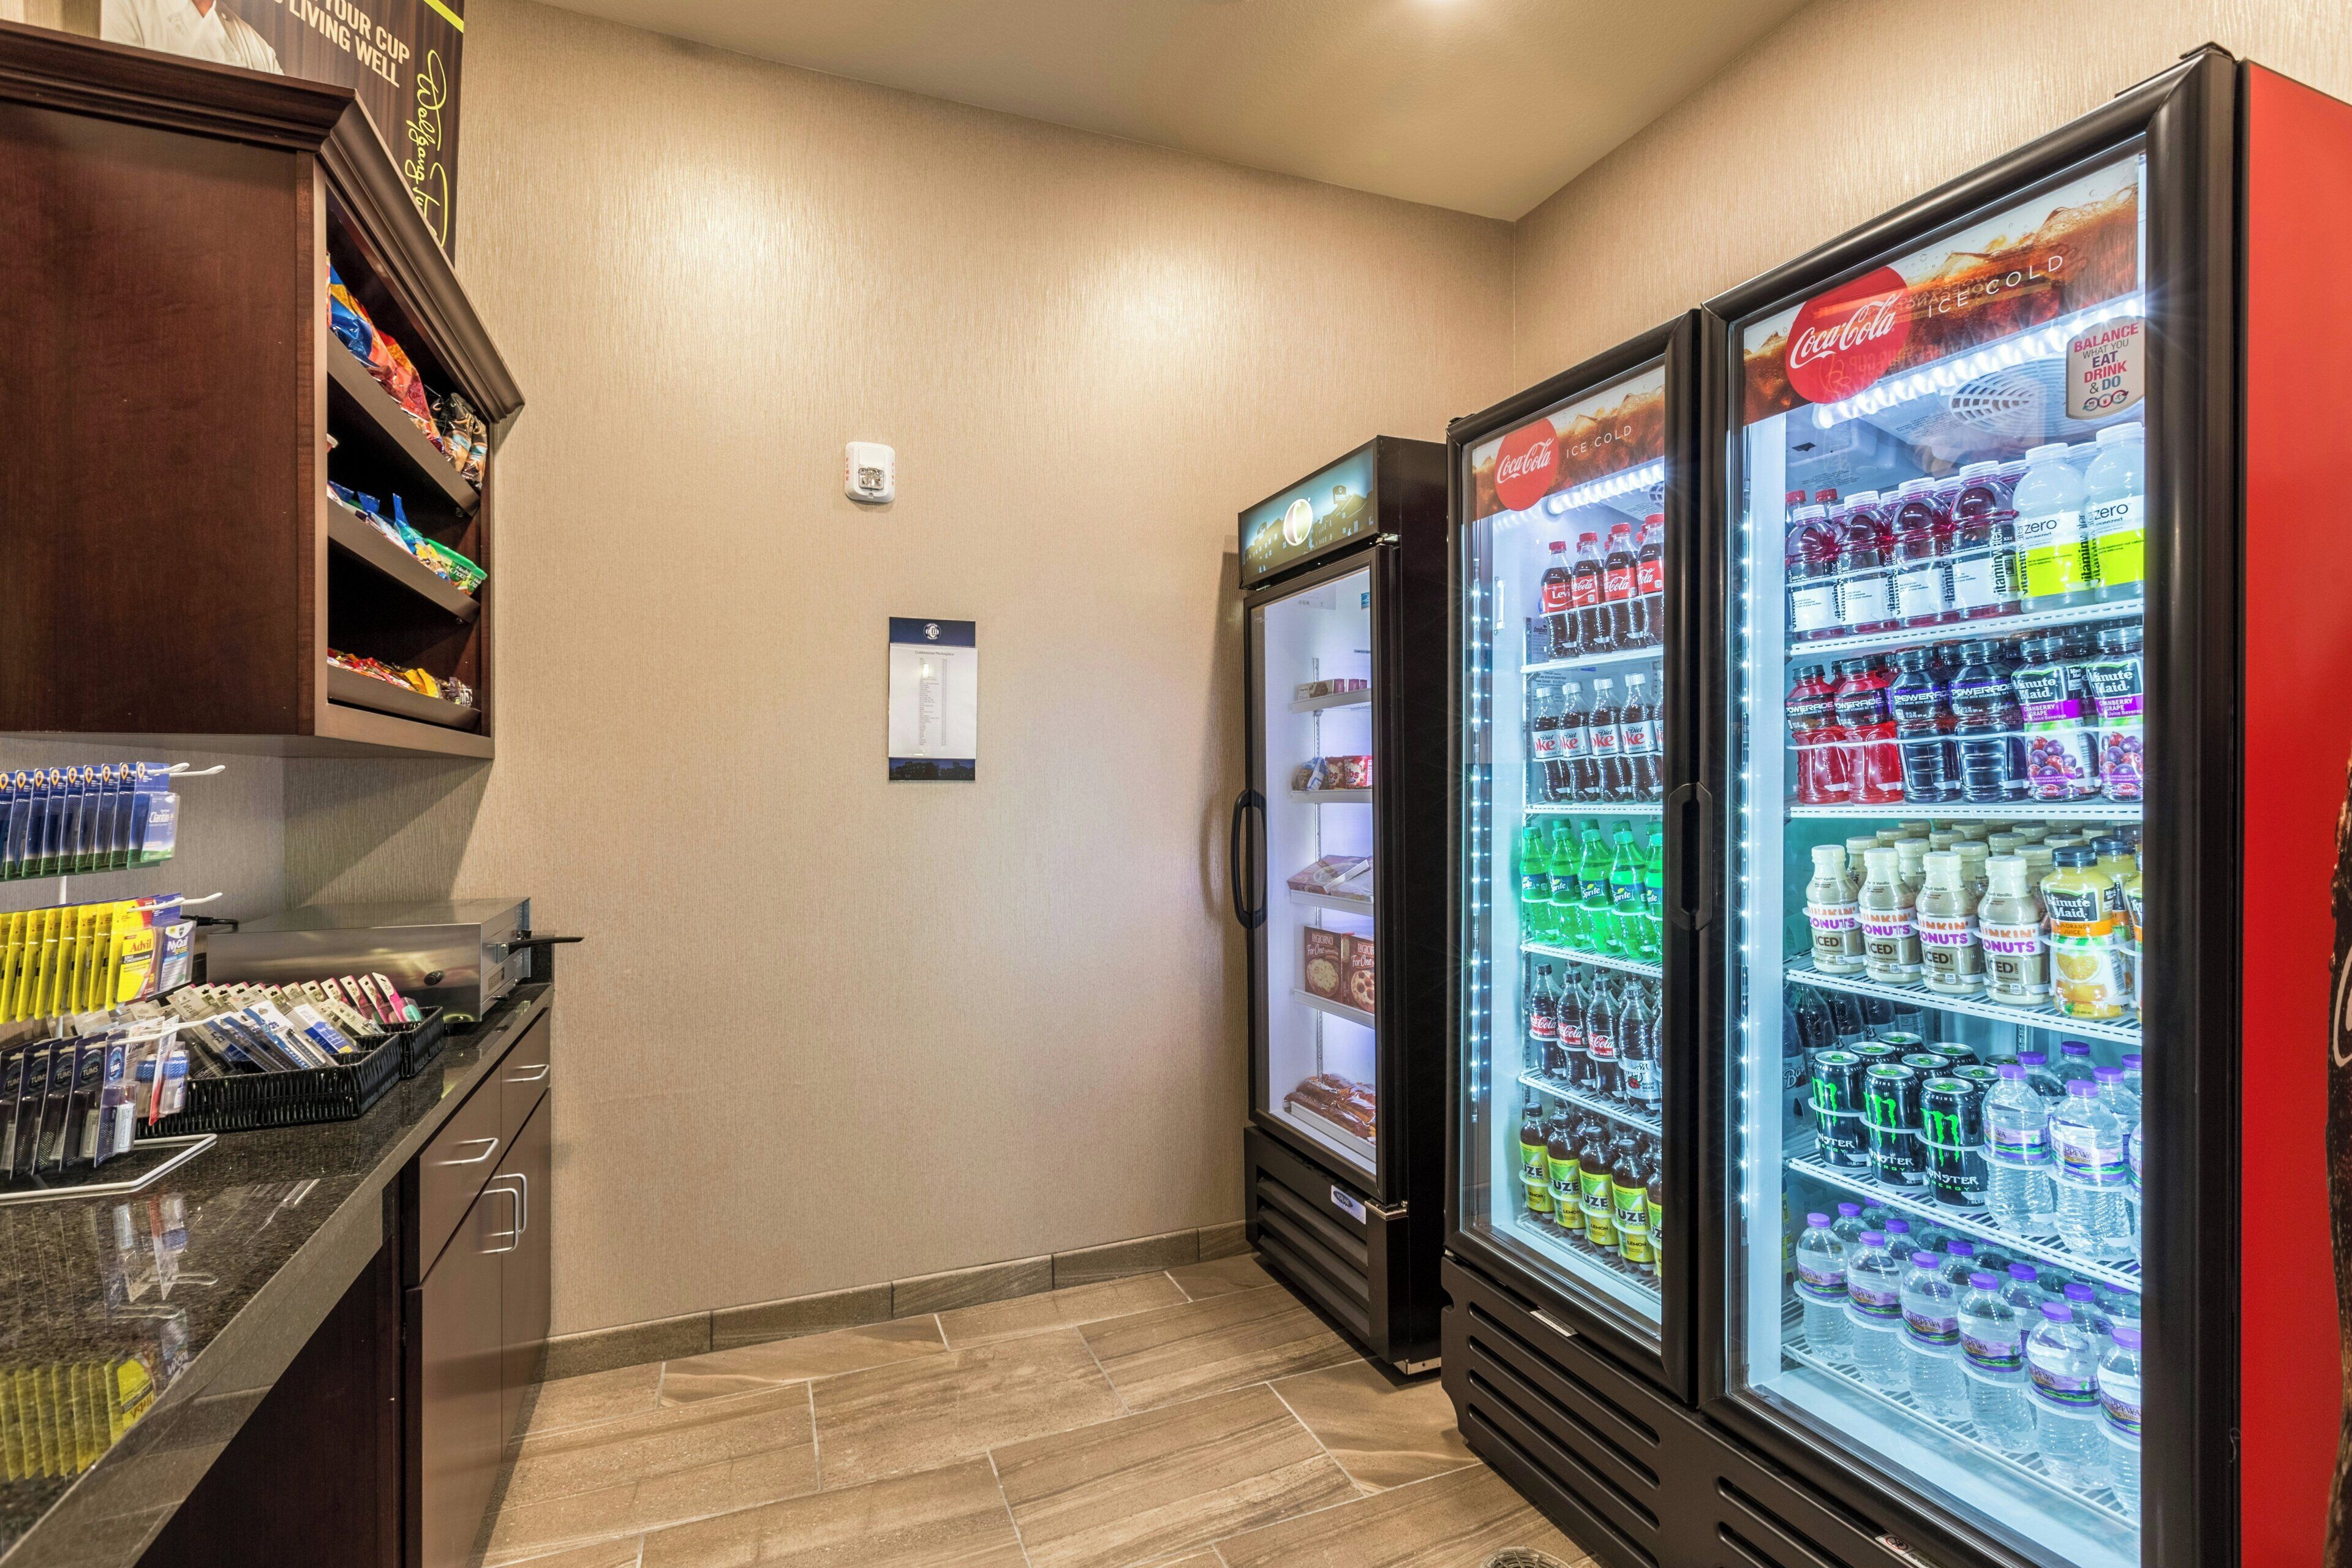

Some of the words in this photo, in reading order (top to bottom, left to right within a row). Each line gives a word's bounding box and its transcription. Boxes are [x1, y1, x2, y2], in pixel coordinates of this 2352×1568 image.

[289, 0, 350, 53] LIVING
[355, 36, 400, 88] WELL
[376, 26, 410, 64] CUP
[1928, 292, 1969, 318] ICE
[1986, 255, 2064, 296] COLD
[1790, 289, 1904, 369] Coca-Cola
[2074, 322, 2139, 353] BALANCE
[2082, 344, 2109, 359] WHAT
[2110, 338, 2130, 350] YOU
[2084, 360, 2127, 383] DRINK
[2089, 382, 2099, 394] &
[2102, 375, 2121, 391] DO
[1566, 442, 1587, 458] ICE
[1594, 425, 1632, 447] COLD
[1496, 435, 1555, 484] Coca-Cola
[2094, 503, 2129, 521] zero
[2024, 519, 2058, 534] zero
[2013, 677, 2057, 690] Minute
[2089, 669, 2133, 684] Minute
[1951, 684, 2013, 697] POWERADE
[149, 811, 170, 824] Claritin
[1582, 888, 1600, 897] Sprite
[1613, 892, 1632, 901] Sprite
[2046, 895, 2090, 908] Minute
[130, 939, 151, 952] Advil
[167, 937, 189, 952] NyQuil
[1314, 943, 1324, 956] One
[1815, 936, 1839, 948] ICED
[1868, 942, 1893, 955] ICED
[1351, 954, 1361, 967] For
[1361, 954, 1372, 967] One
[1923, 949, 1949, 965] ICED
[1987, 957, 2014, 974] ICED
[82, 1066, 99, 1076] TUMS
[110, 1063, 120, 1074] TUMS
